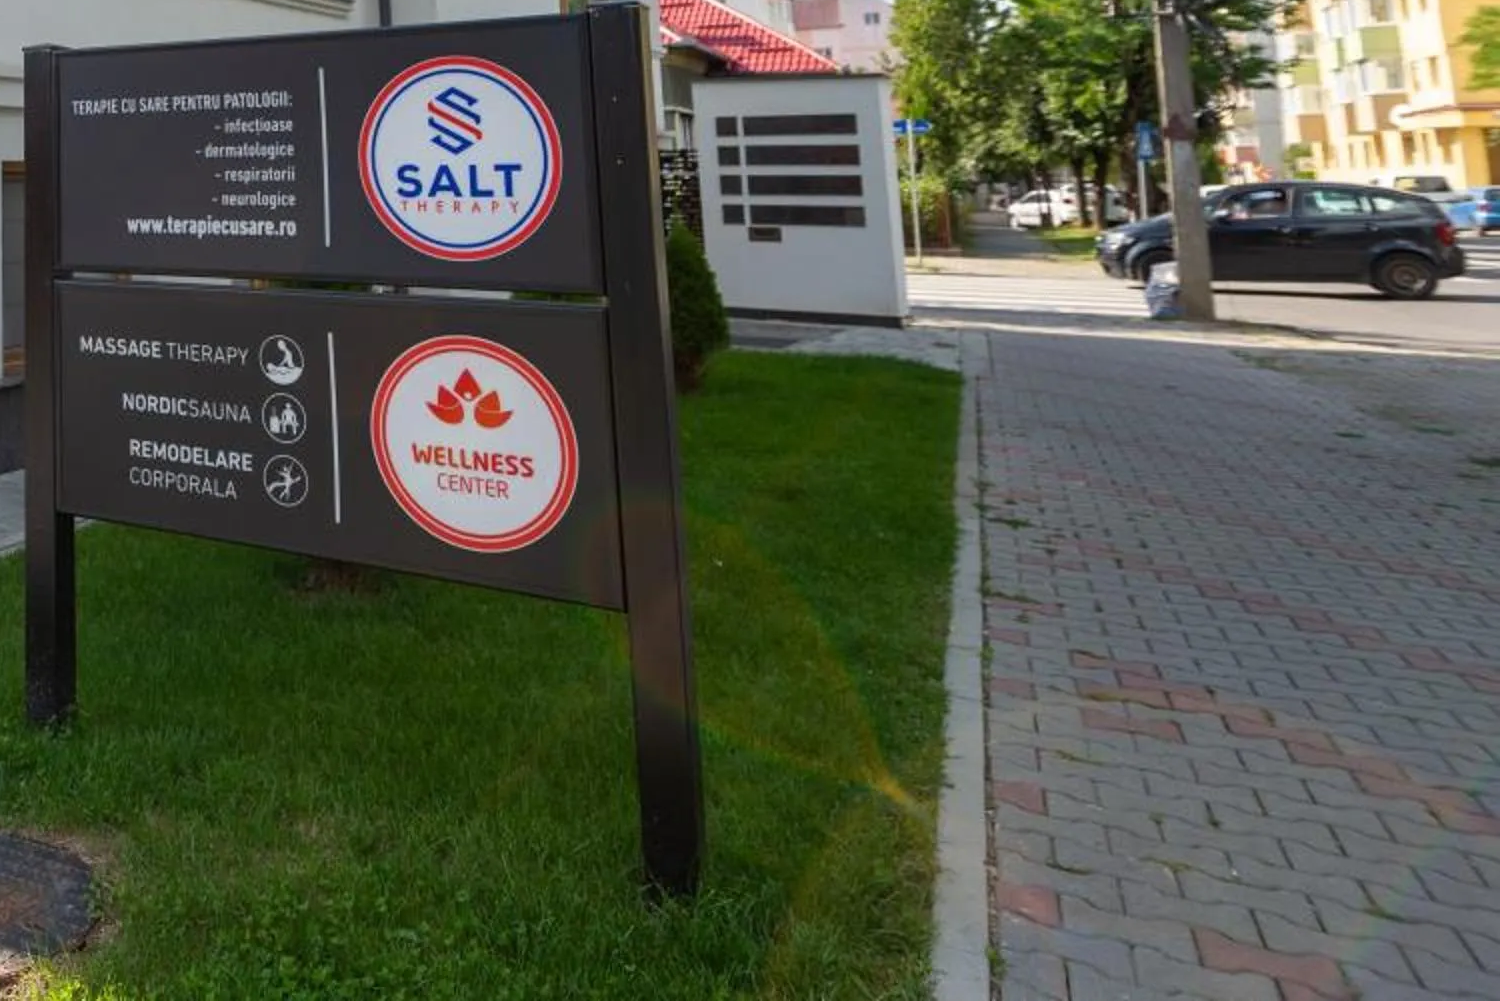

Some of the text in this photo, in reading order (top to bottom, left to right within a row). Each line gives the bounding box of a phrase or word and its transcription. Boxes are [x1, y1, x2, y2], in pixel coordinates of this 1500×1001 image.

[71, 91, 293, 116] TERAPIE CU SARE PENTRU PATOLOGII:
[204, 141, 295, 160] dermatologice
[225, 166, 296, 184] respiratorii
[397, 164, 522, 198] SALT
[221, 190, 297, 210] neurologice
[400, 200, 520, 214] THERAPY
[126, 213, 297, 239] www.terapiecusare.ro
[79, 335, 250, 367] MASSAGE THERAPY
[128, 438, 254, 473] REMODELARE
[411, 442, 535, 479] WELLNESS
[128, 466, 238, 500] CORPORALA
[436, 472, 510, 500] CENTER
